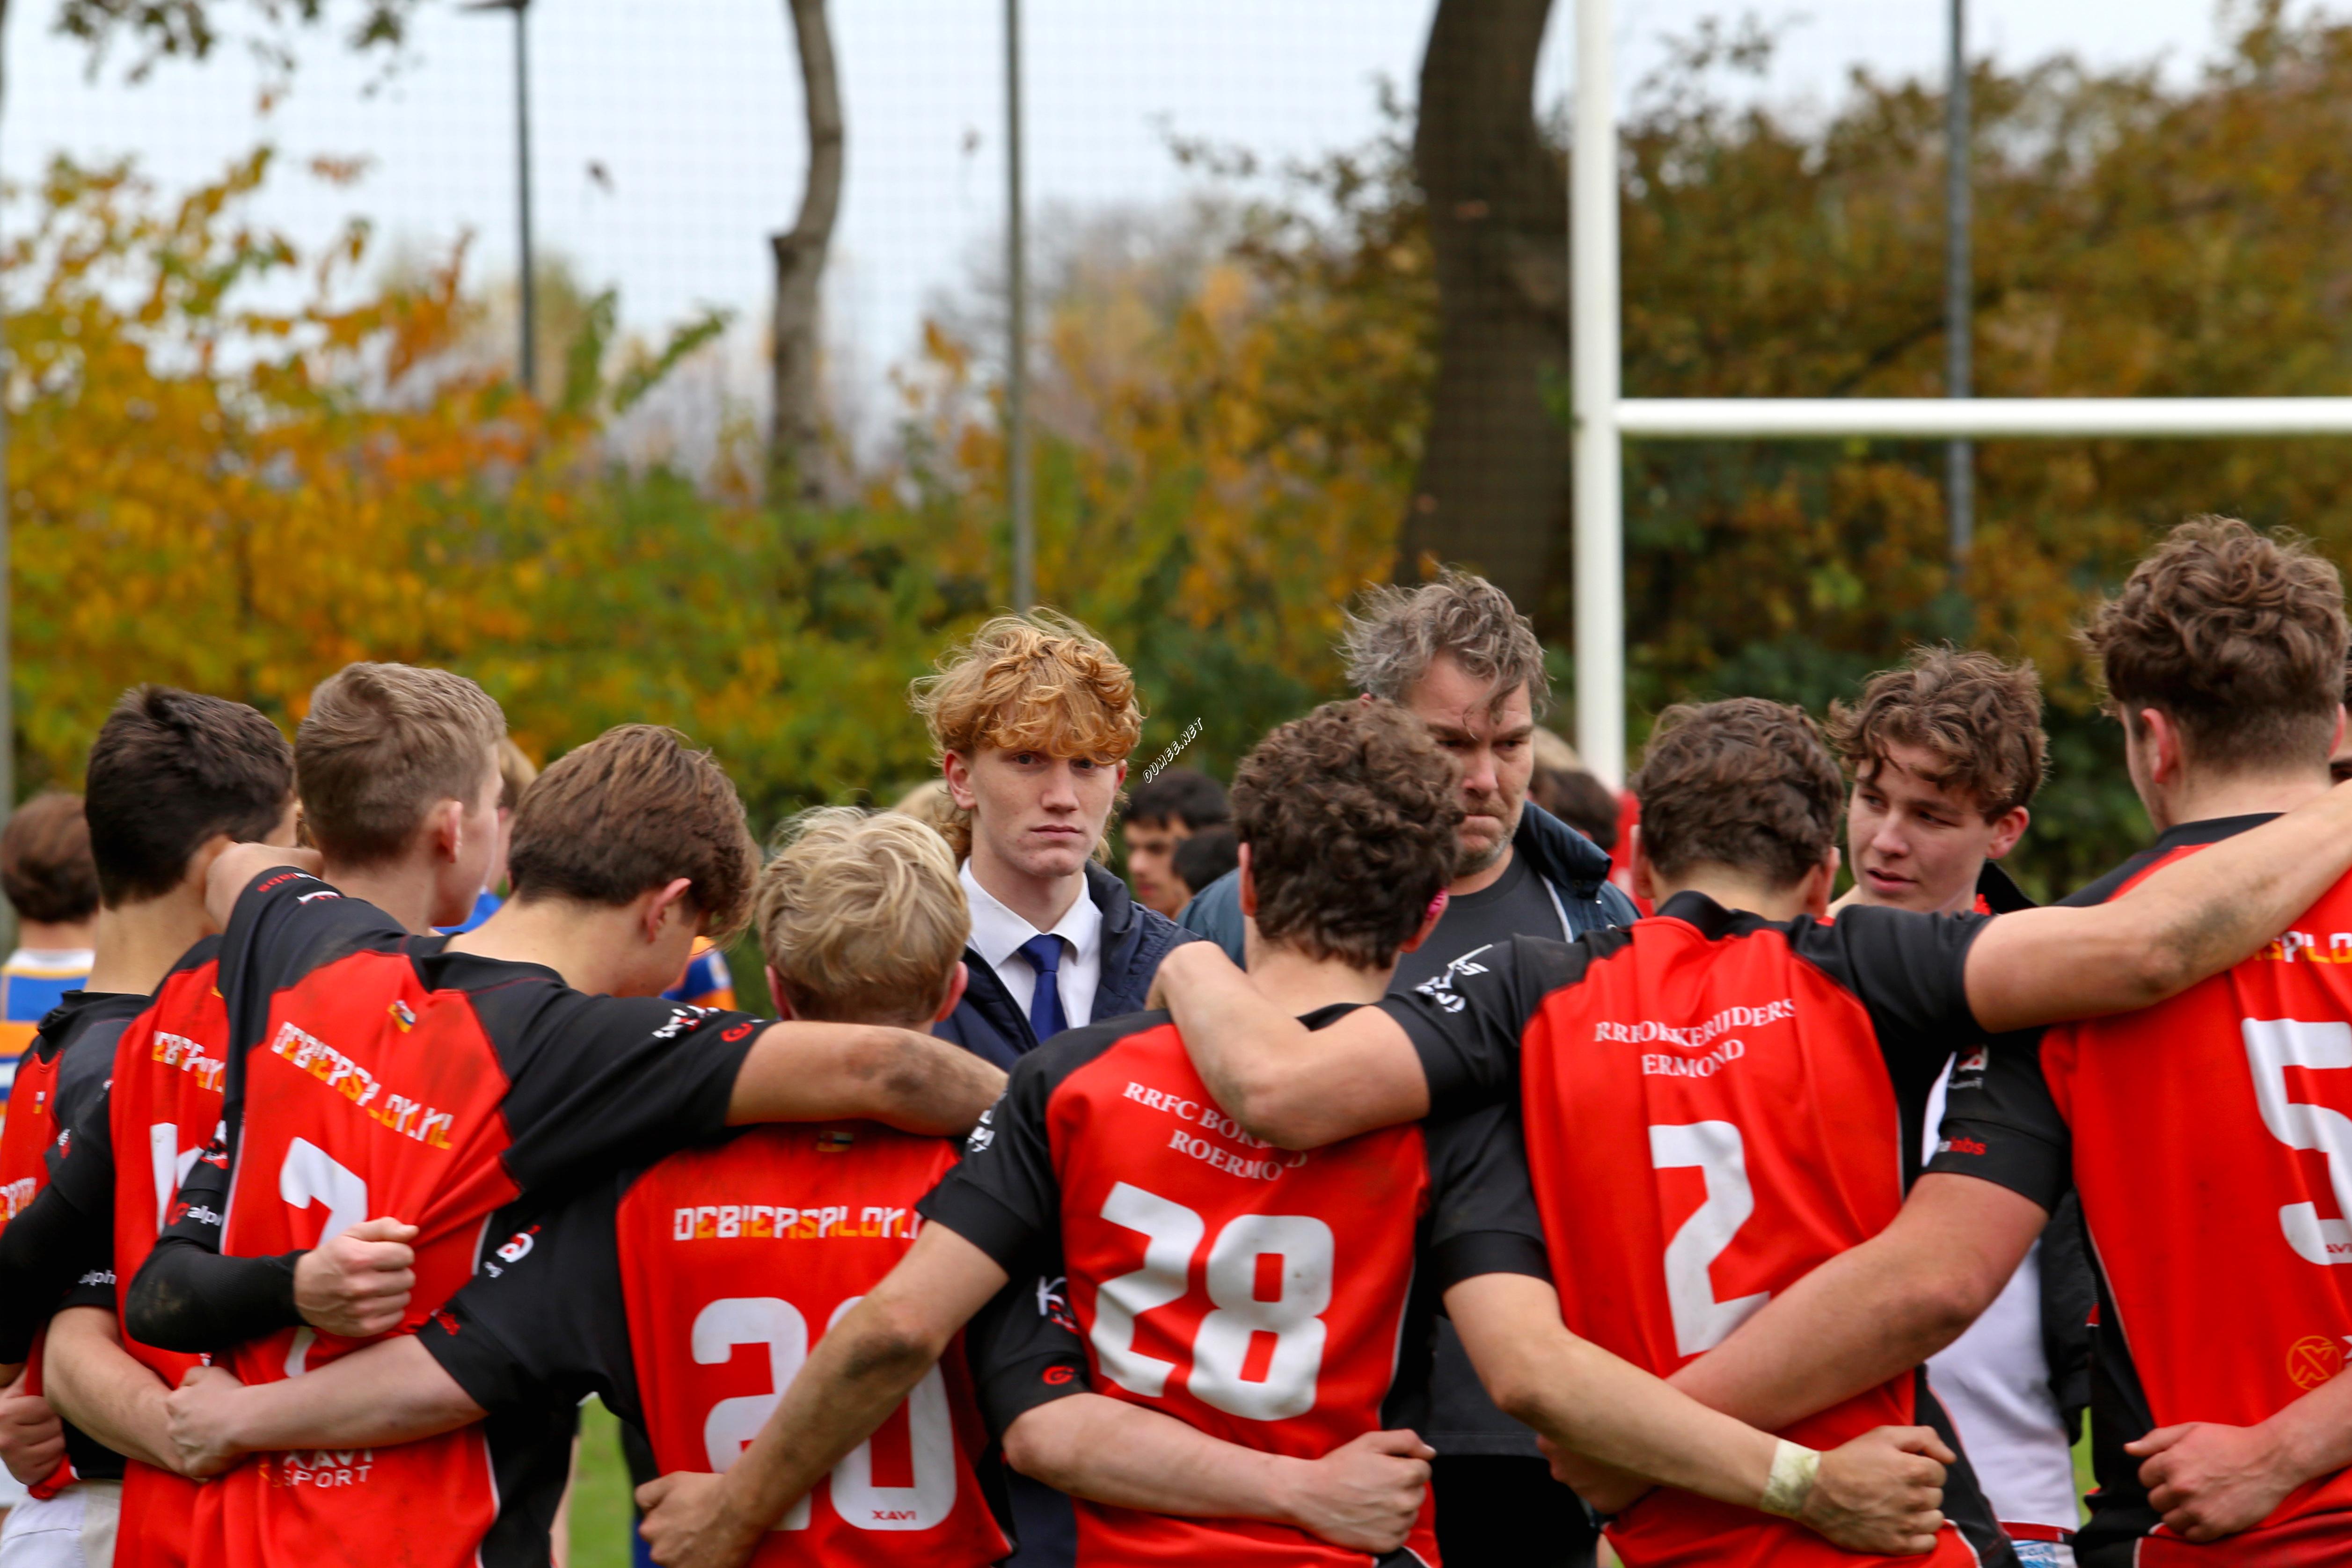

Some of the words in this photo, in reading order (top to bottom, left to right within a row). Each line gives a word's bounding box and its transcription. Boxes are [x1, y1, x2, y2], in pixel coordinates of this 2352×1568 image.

[1122, 1081, 1199, 1120] RRFC
[1641, 1039, 1746, 1078] ERMOND
[1089, 1181, 1335, 1422] 28
[1647, 1119, 1772, 1357] 2
[691, 1296, 958, 1531] 20
[872, 1510, 916, 1520] XAVI
